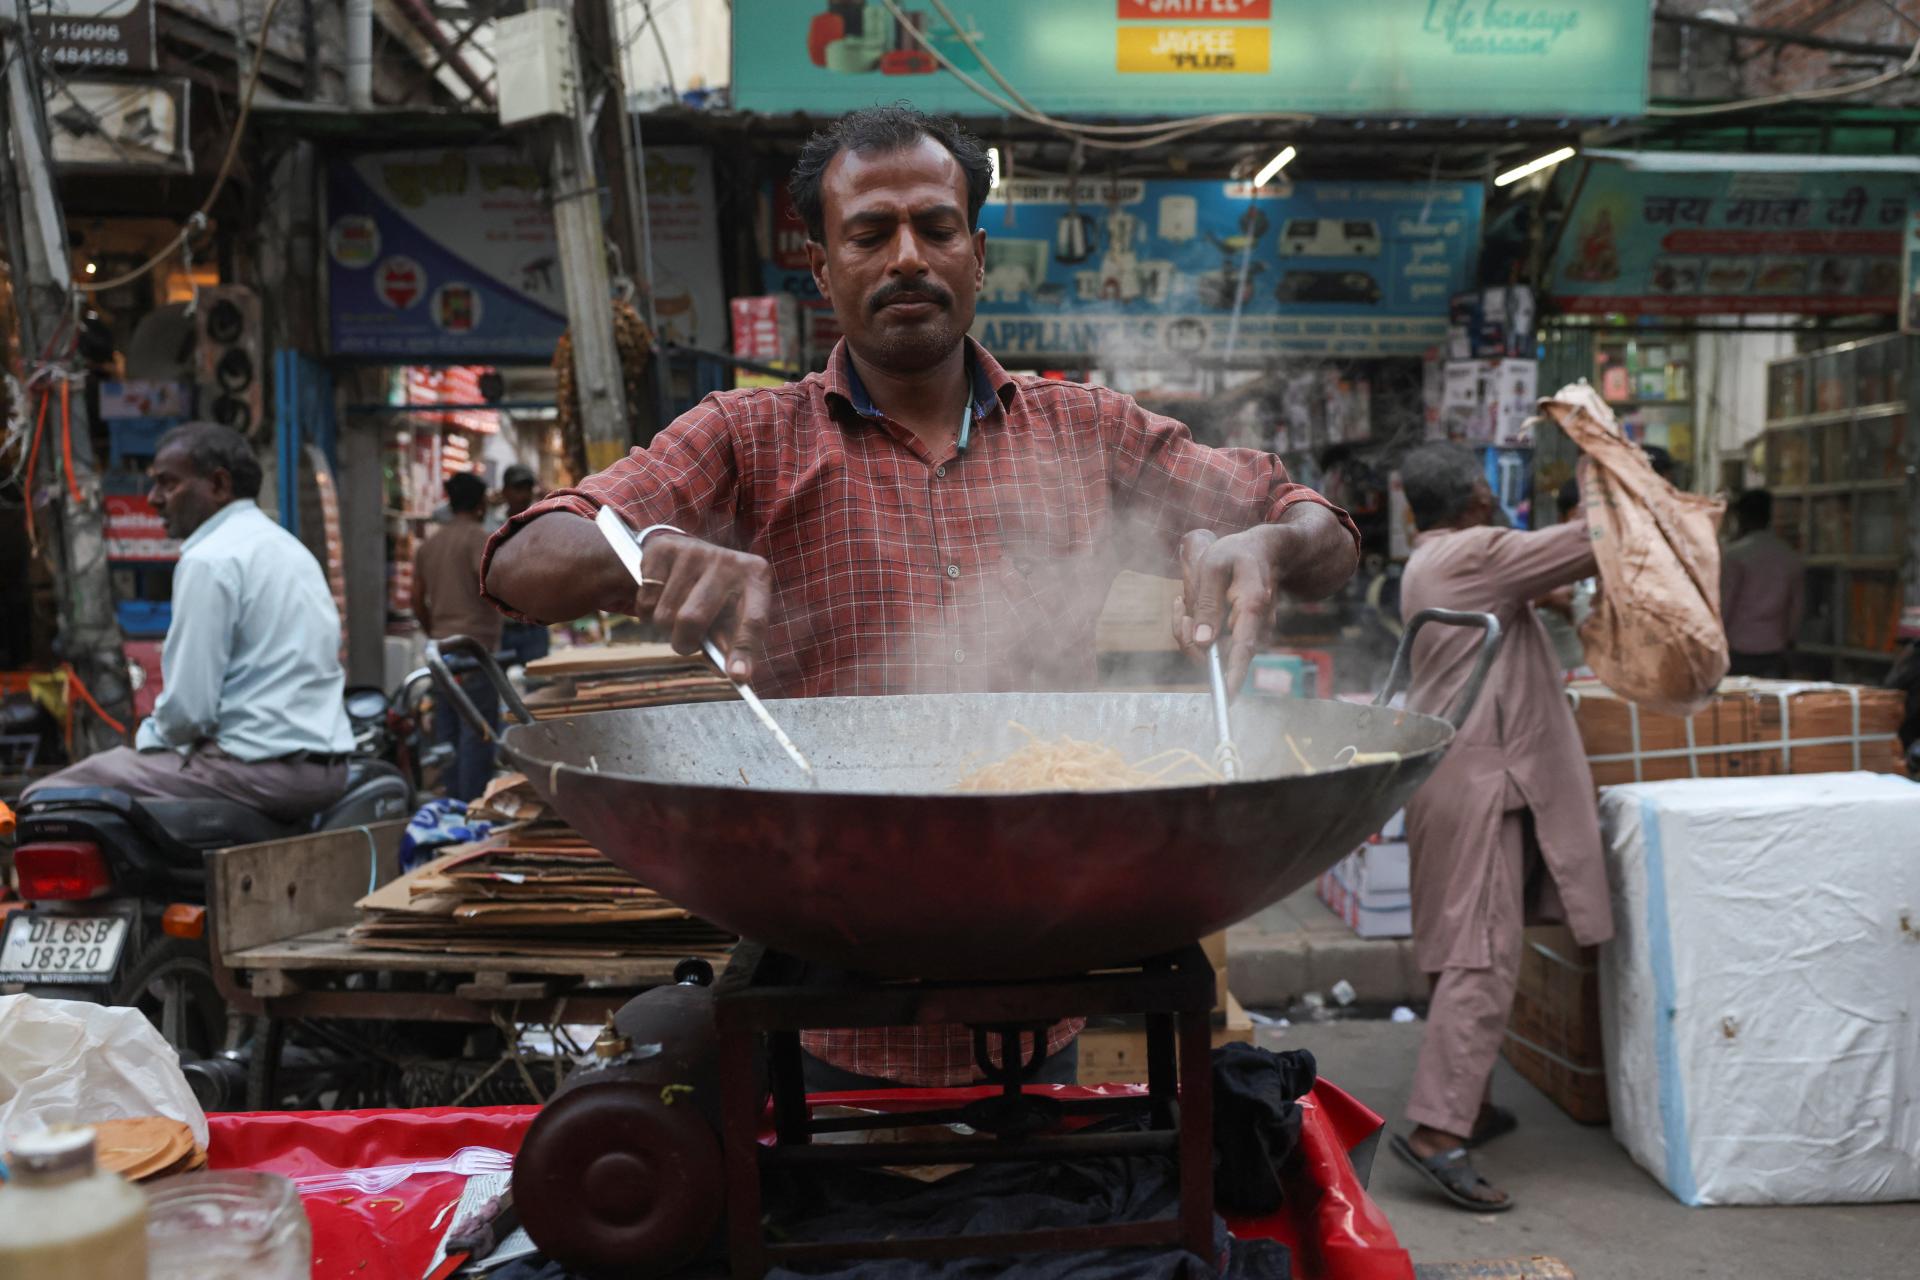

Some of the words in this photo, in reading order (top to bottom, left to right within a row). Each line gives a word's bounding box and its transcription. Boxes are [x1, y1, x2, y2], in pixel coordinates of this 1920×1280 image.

[1151, 29, 1235, 54] JAYPEE
[1171, 53, 1235, 70] PLUS
[29, 918, 110, 944] DL6SB
[21, 946, 101, 970] J8320
